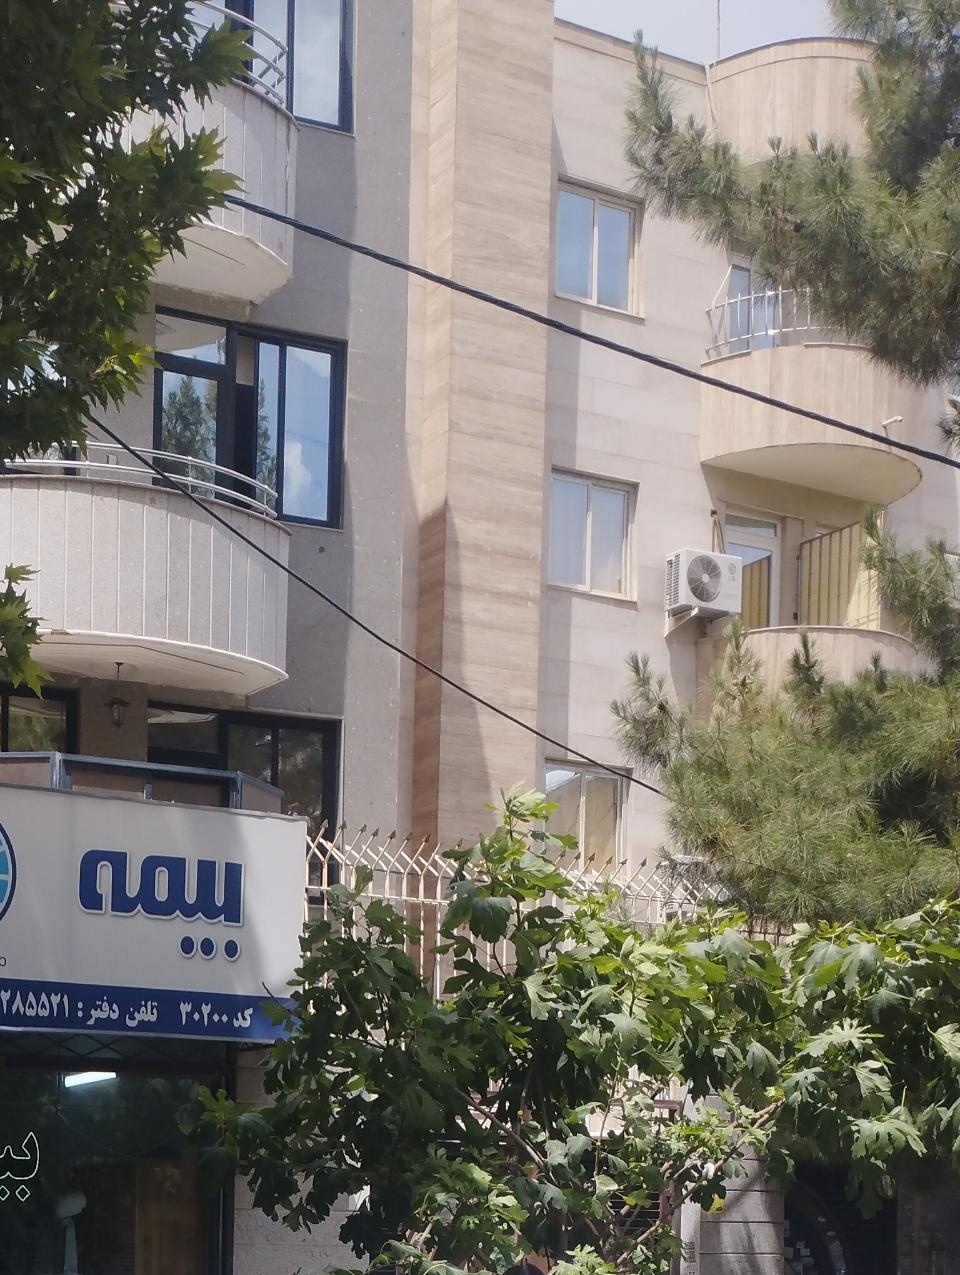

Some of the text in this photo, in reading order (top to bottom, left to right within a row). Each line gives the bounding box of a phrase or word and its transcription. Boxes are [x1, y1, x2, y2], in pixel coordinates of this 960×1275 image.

[78, 849, 244, 962] بیمه
[125, 1000, 158, 1027] تلفن
[179, 1001, 228, 1027] ۳۰۲۰۰
[232, 1007, 254, 1028] کد
